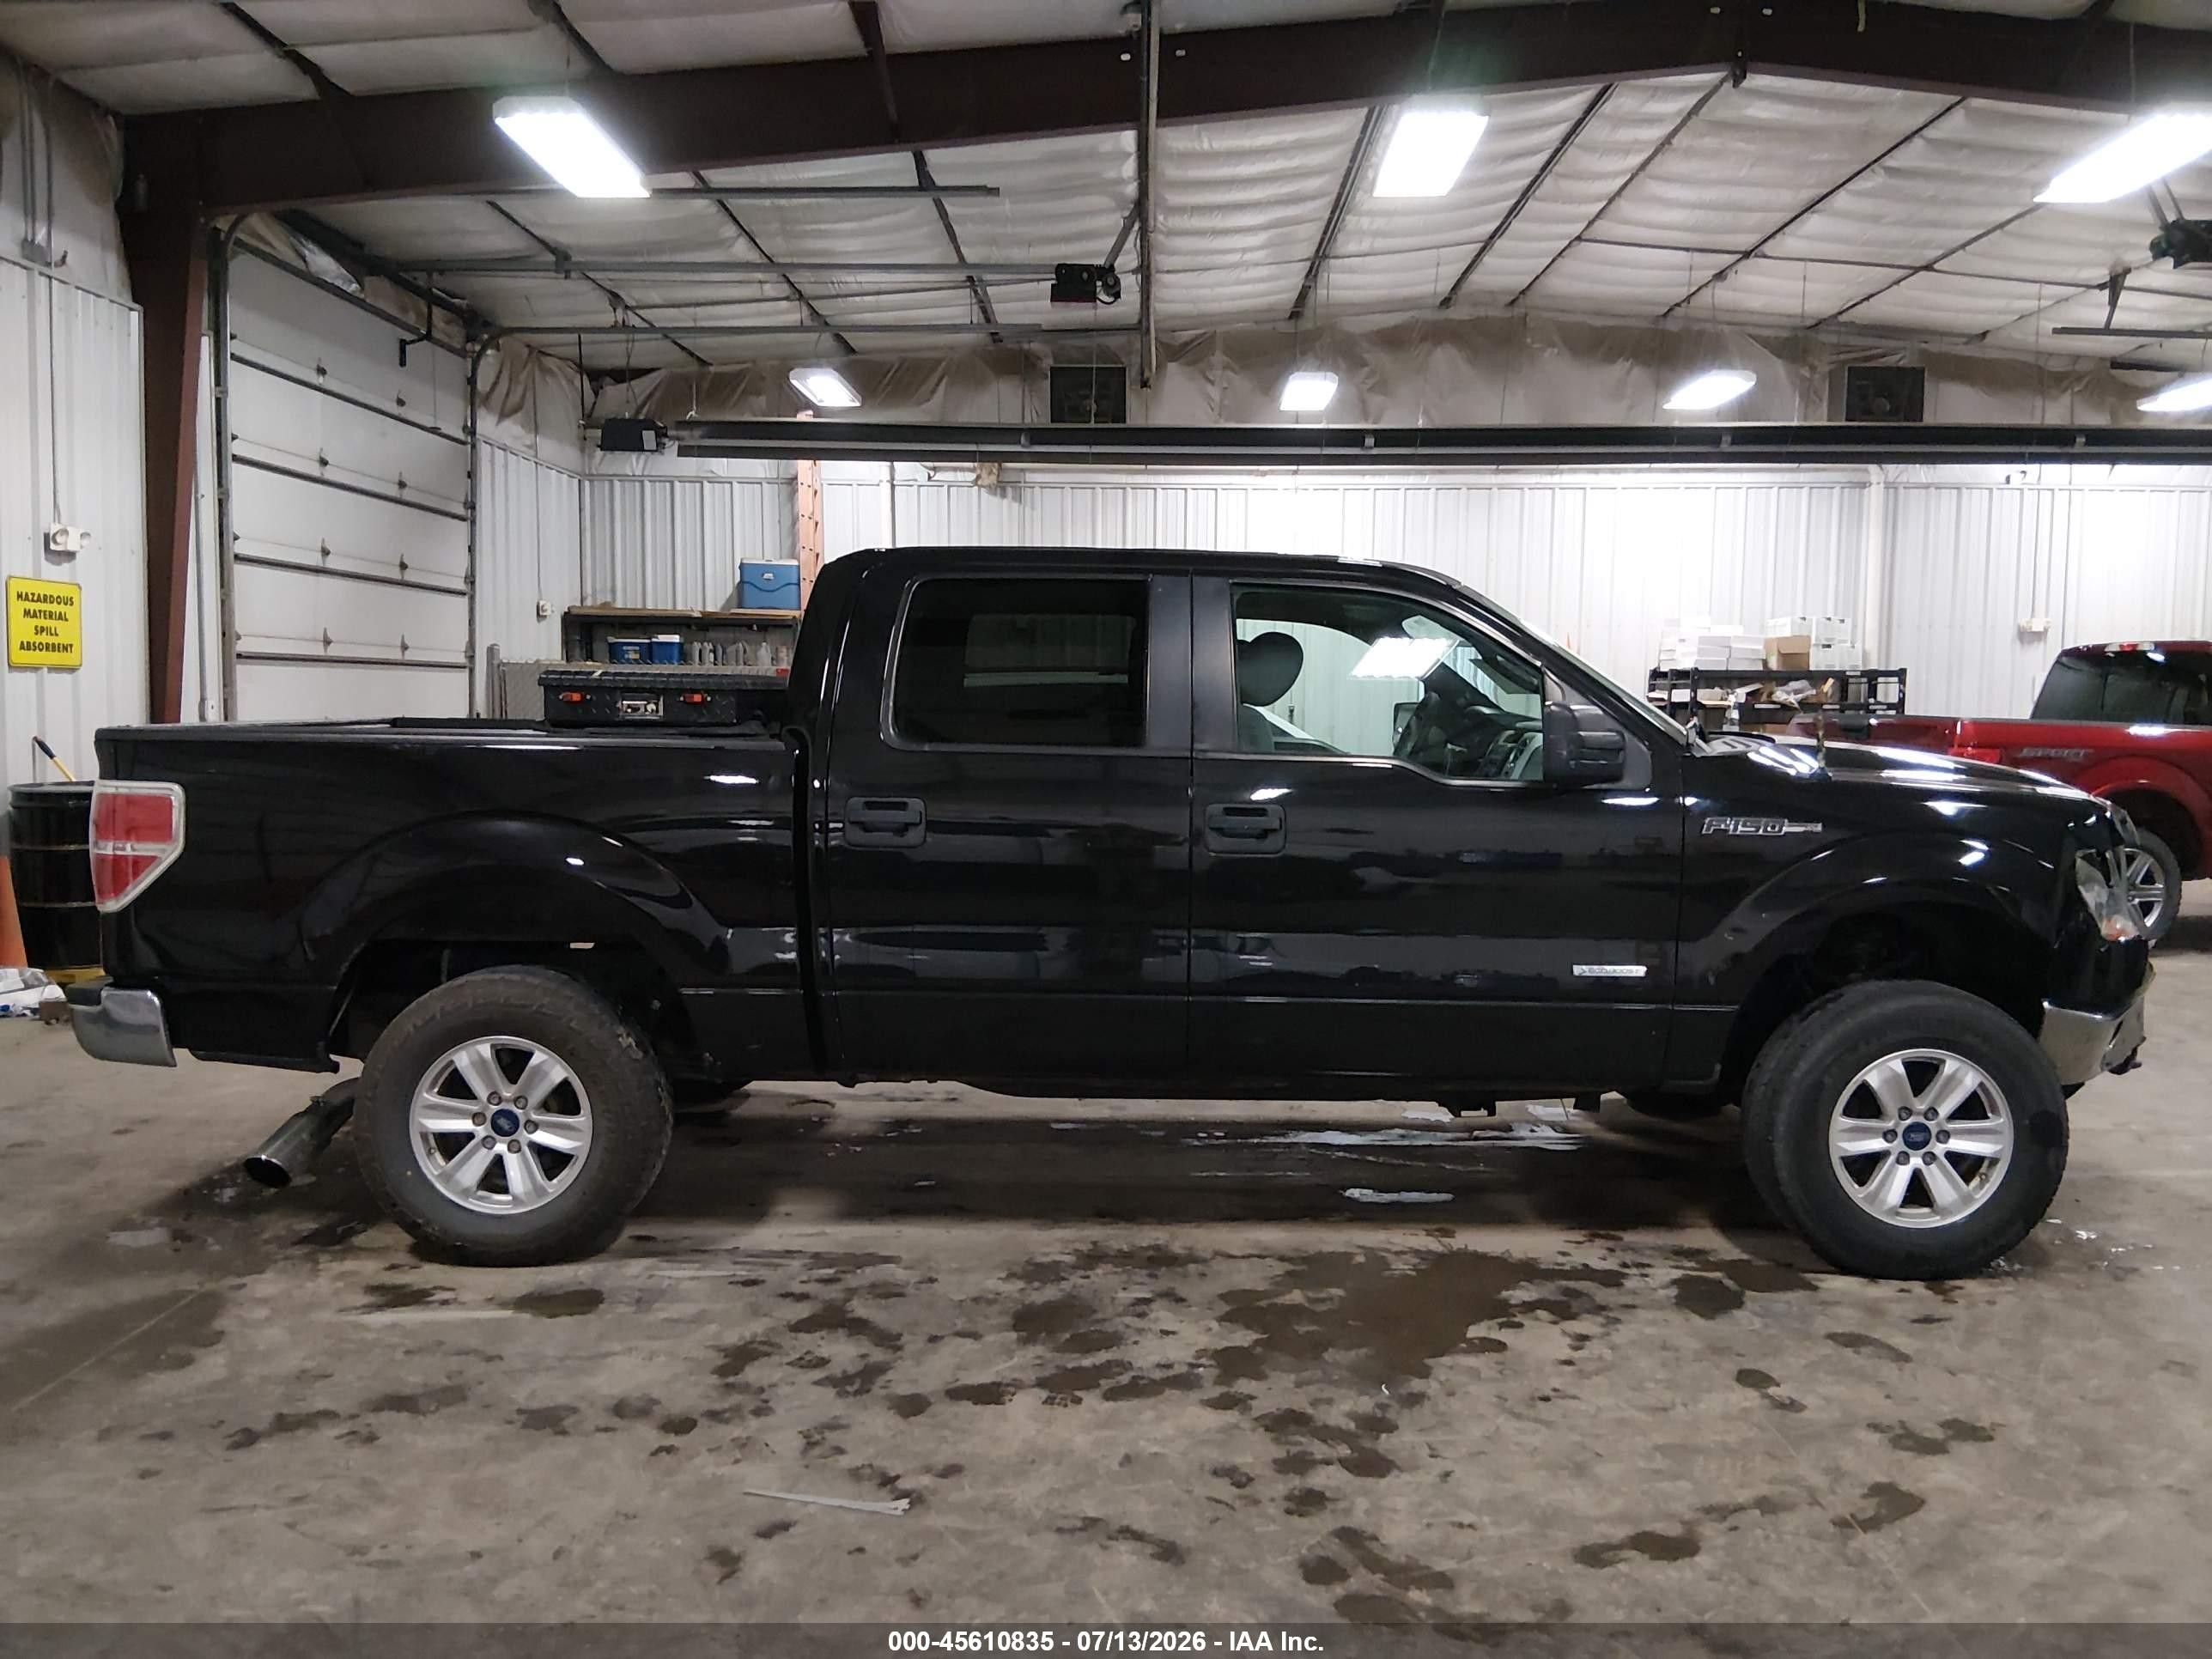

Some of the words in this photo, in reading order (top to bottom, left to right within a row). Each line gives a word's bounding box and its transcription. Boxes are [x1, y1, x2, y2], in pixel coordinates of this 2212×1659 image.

[16, 590, 75, 606] HAZARDOUS
[23, 607, 69, 622] MATERIAL
[33, 624, 59, 637] SPILL
[19, 641, 74, 653] ABSORBENT
